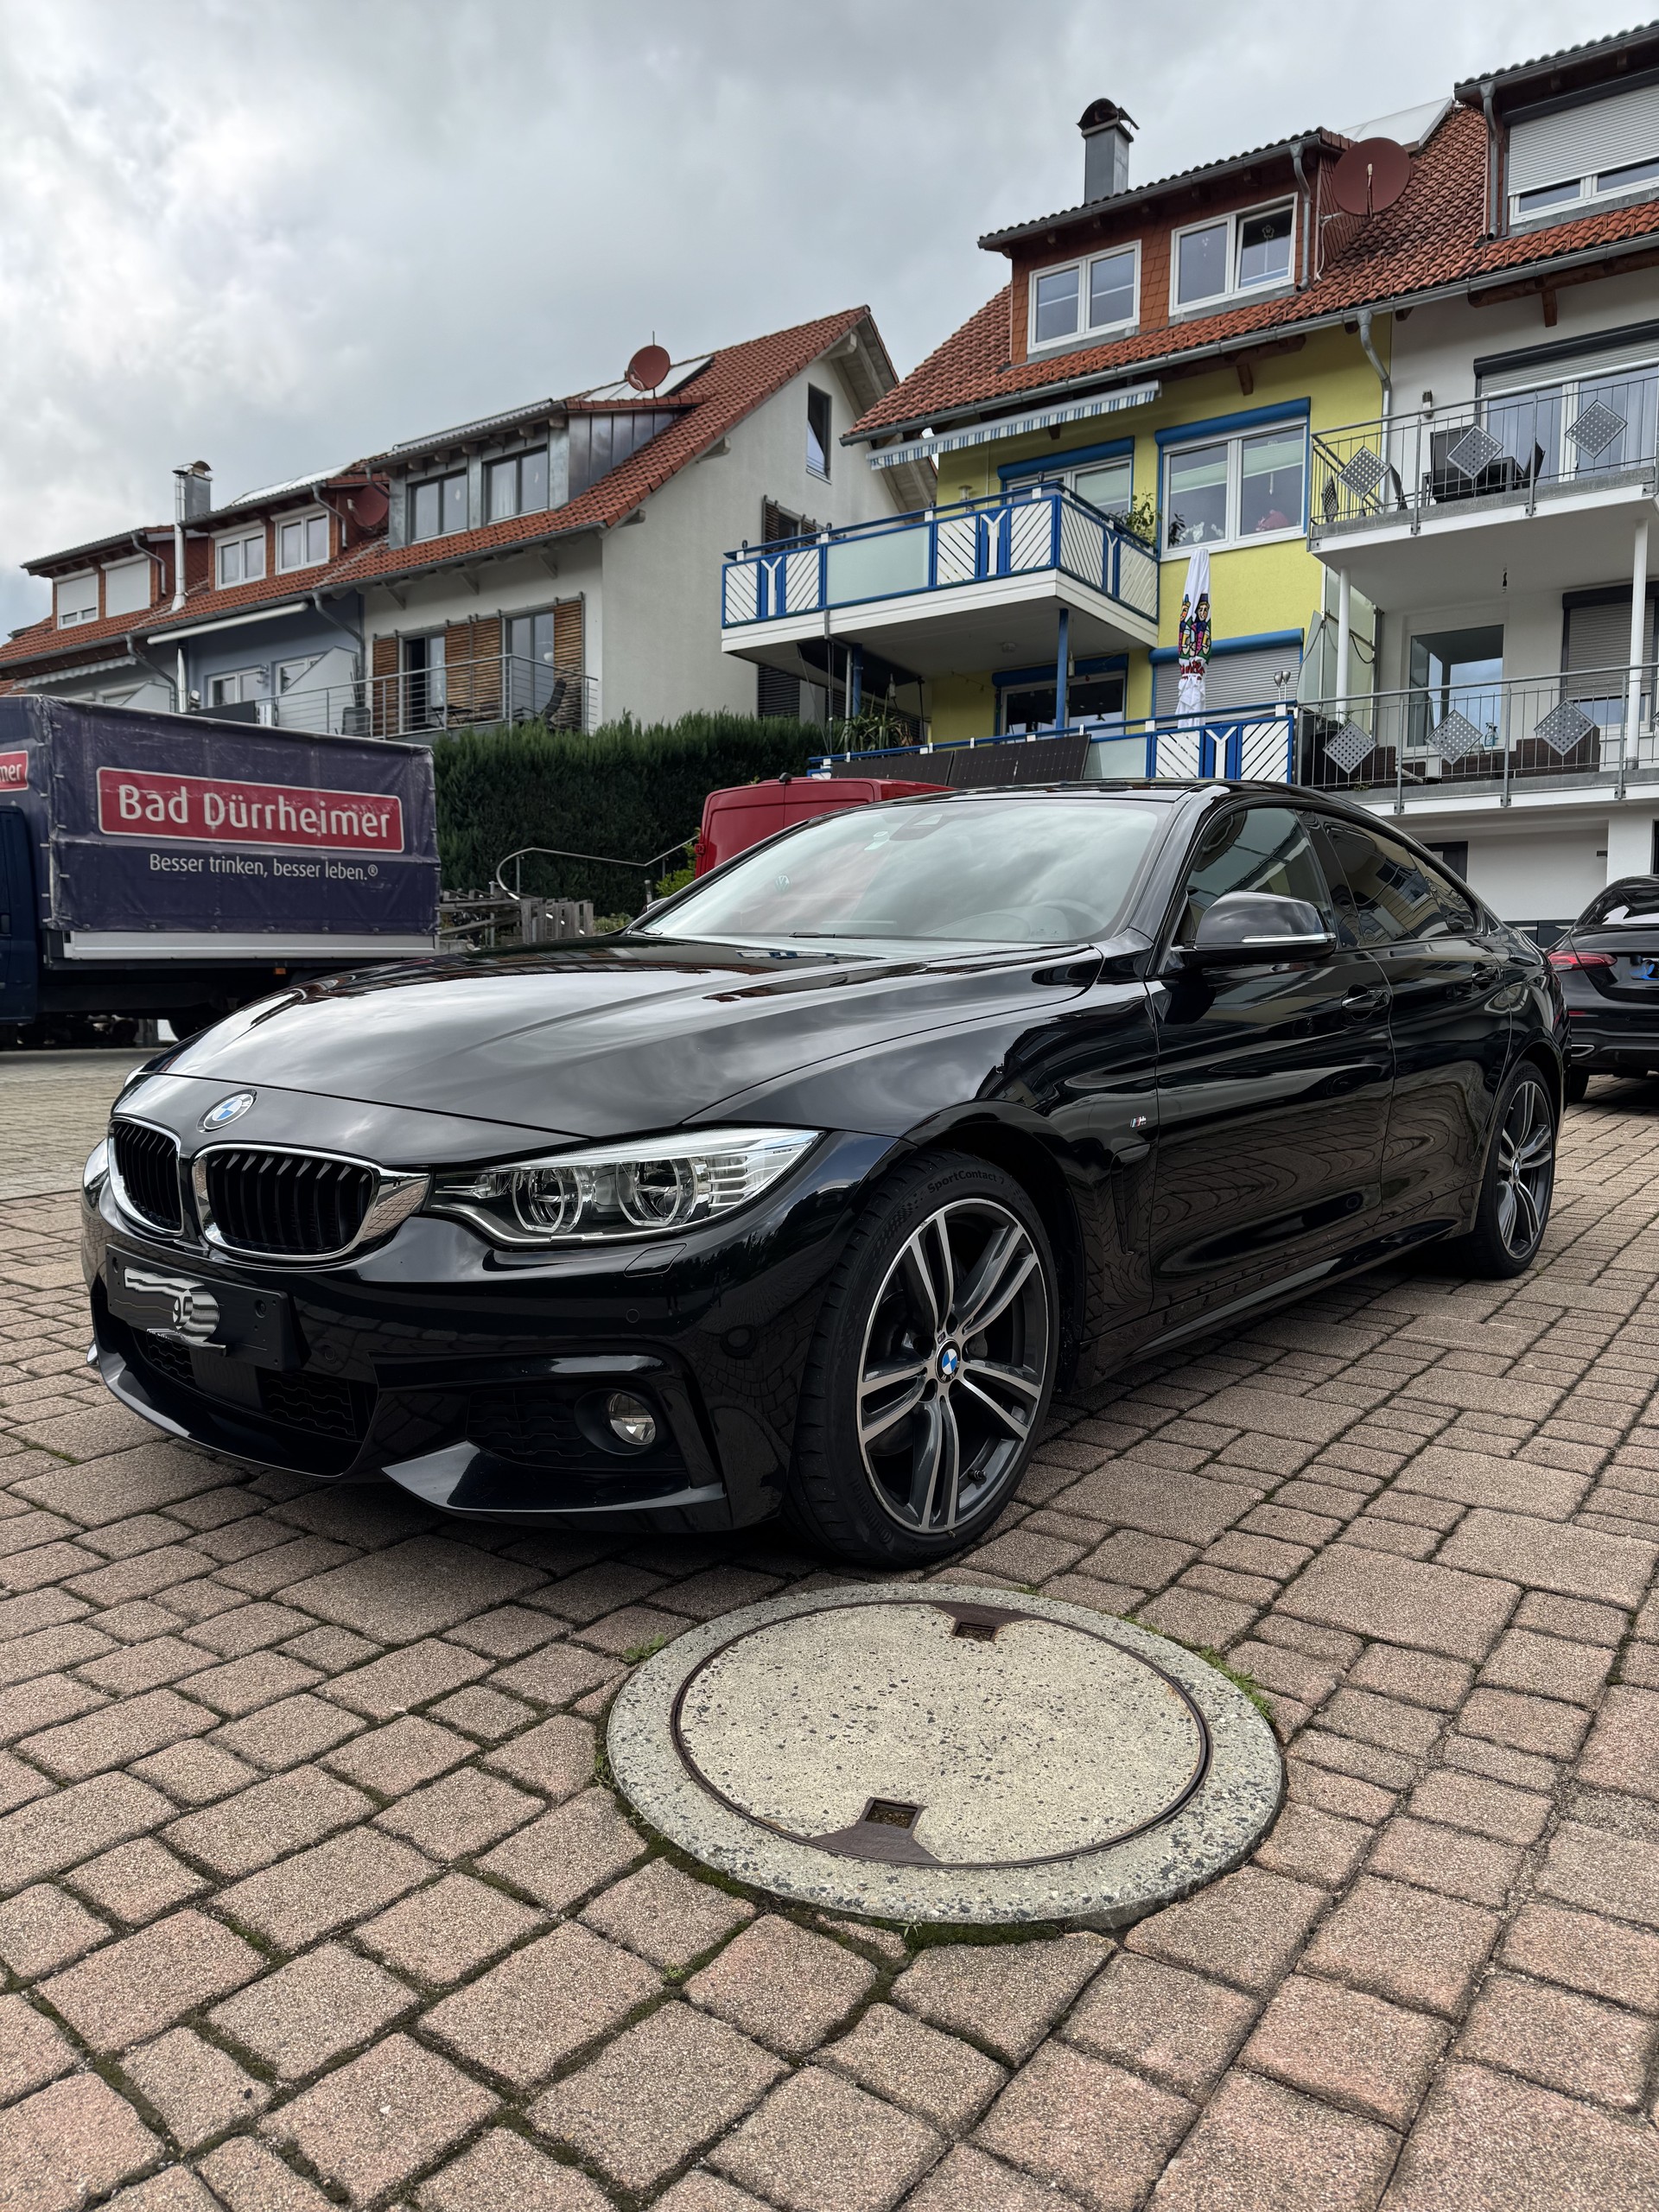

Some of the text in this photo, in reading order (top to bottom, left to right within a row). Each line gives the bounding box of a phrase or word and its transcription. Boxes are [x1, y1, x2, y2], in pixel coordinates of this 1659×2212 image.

[118, 785, 391, 838] Bad Dürrheimer
[149, 853, 204, 873] Besser
[209, 855, 268, 878] trinken,
[273, 858, 321, 878] besser
[927, 1170, 1005, 1193] SportContact 7
